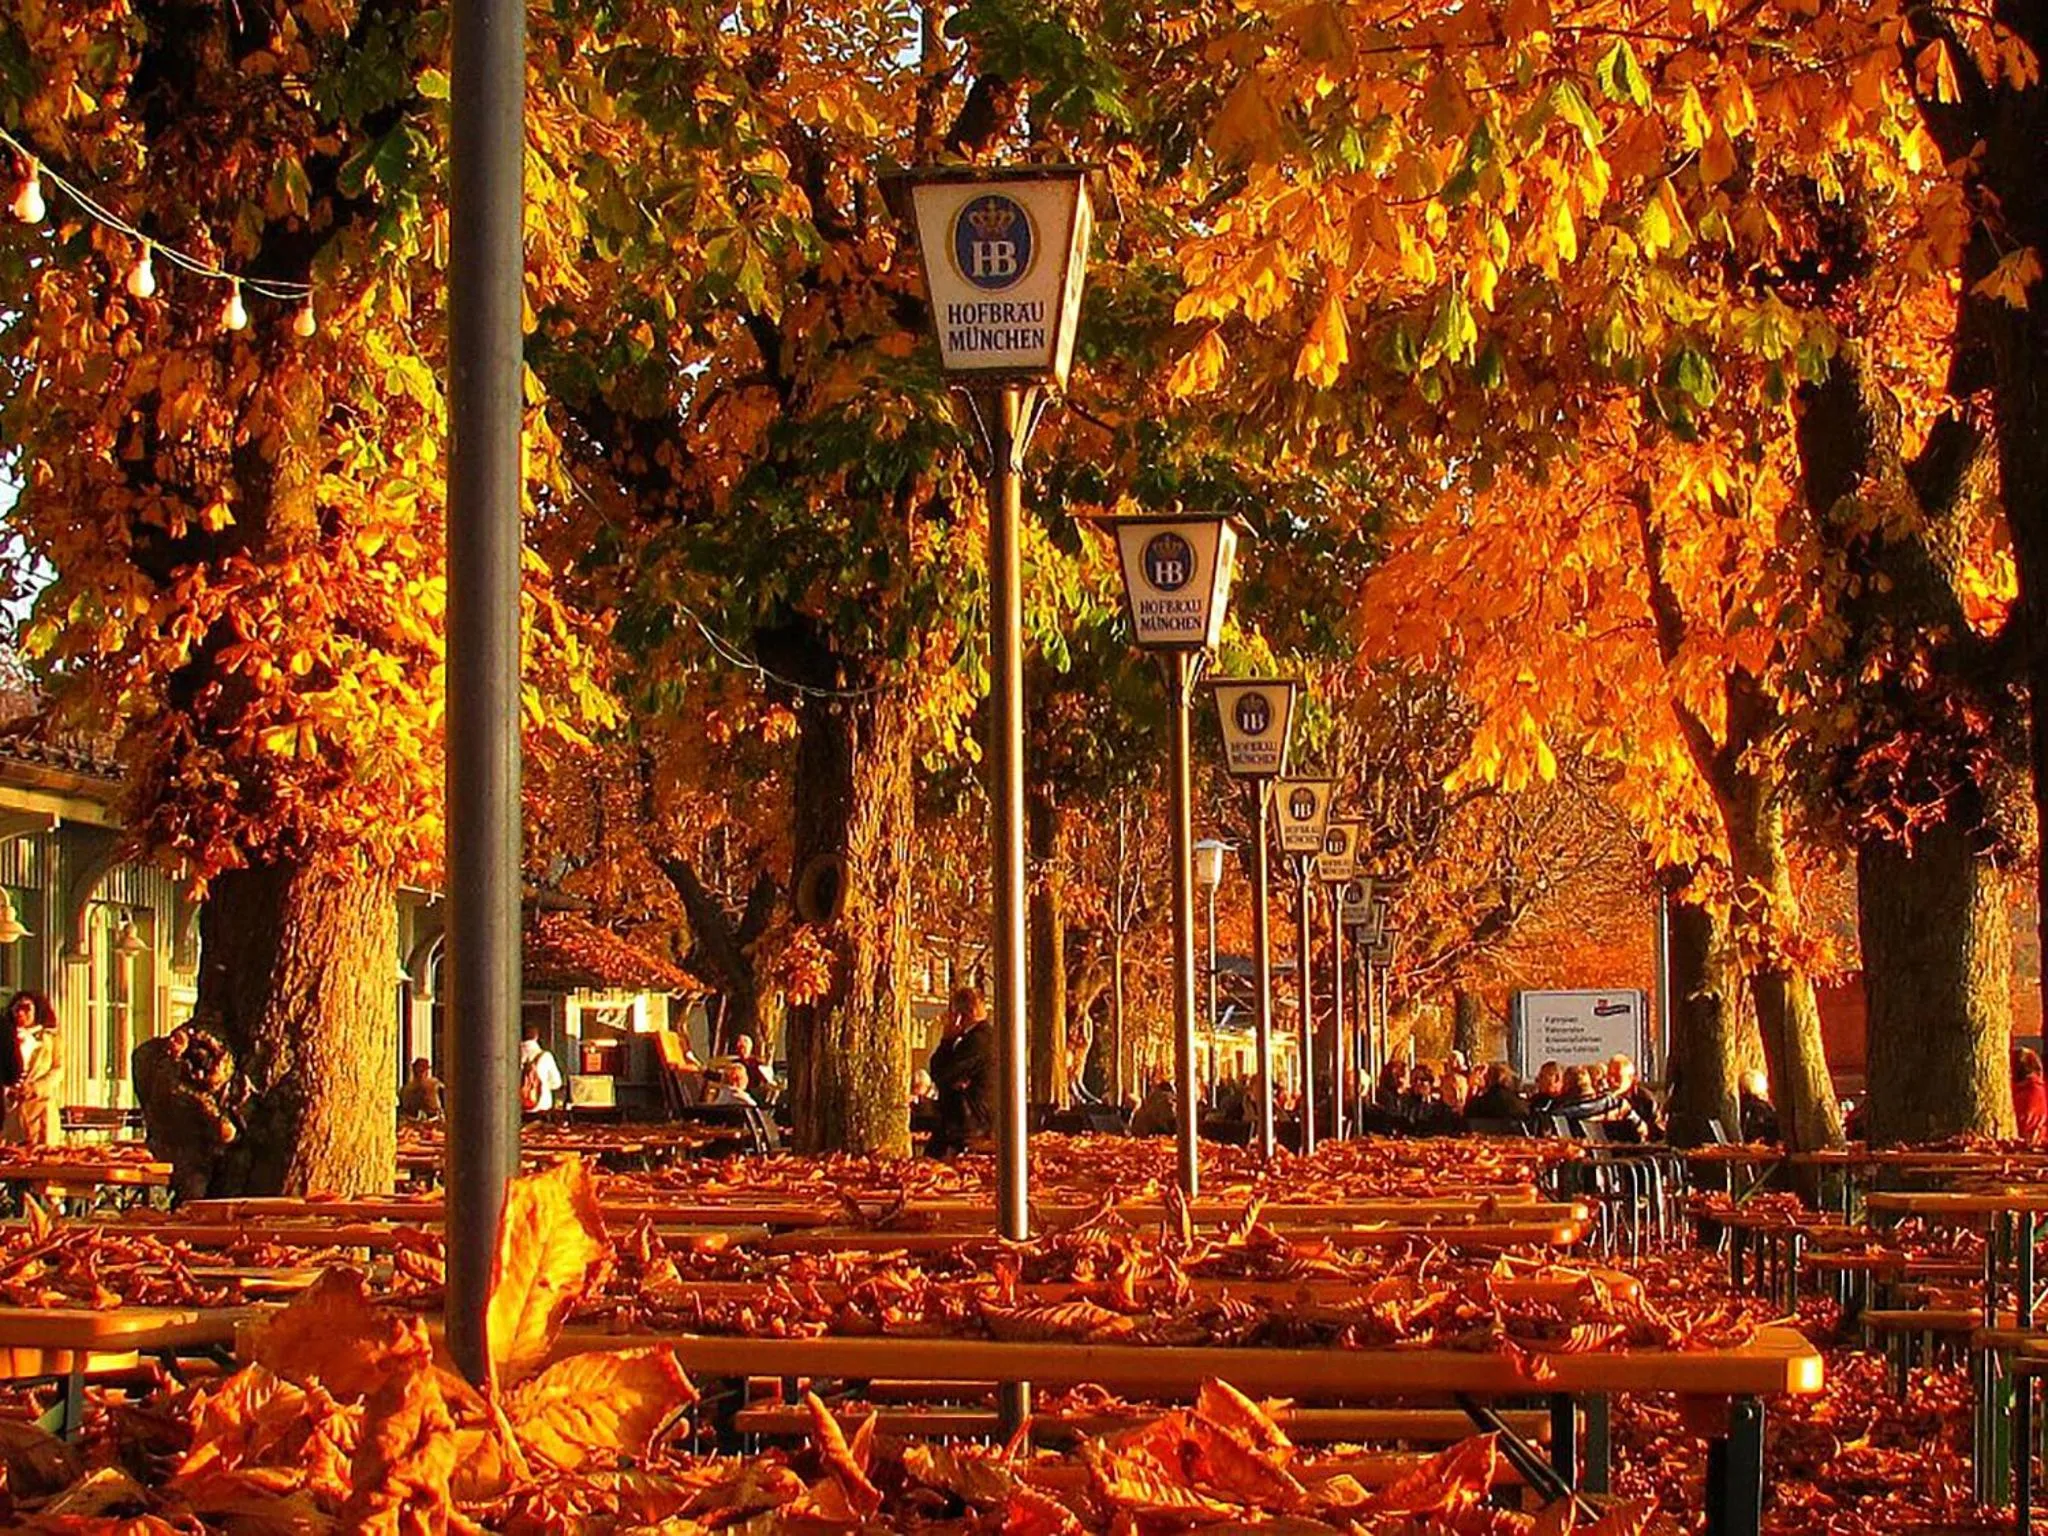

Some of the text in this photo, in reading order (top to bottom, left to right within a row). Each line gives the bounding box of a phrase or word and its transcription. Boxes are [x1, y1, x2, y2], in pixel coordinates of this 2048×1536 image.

[971, 240, 1017, 277] HB
[948, 300, 1044, 324] HOFBRÄU
[949, 326, 1045, 351] MÜNCHEN
[1155, 560, 1183, 584] HB
